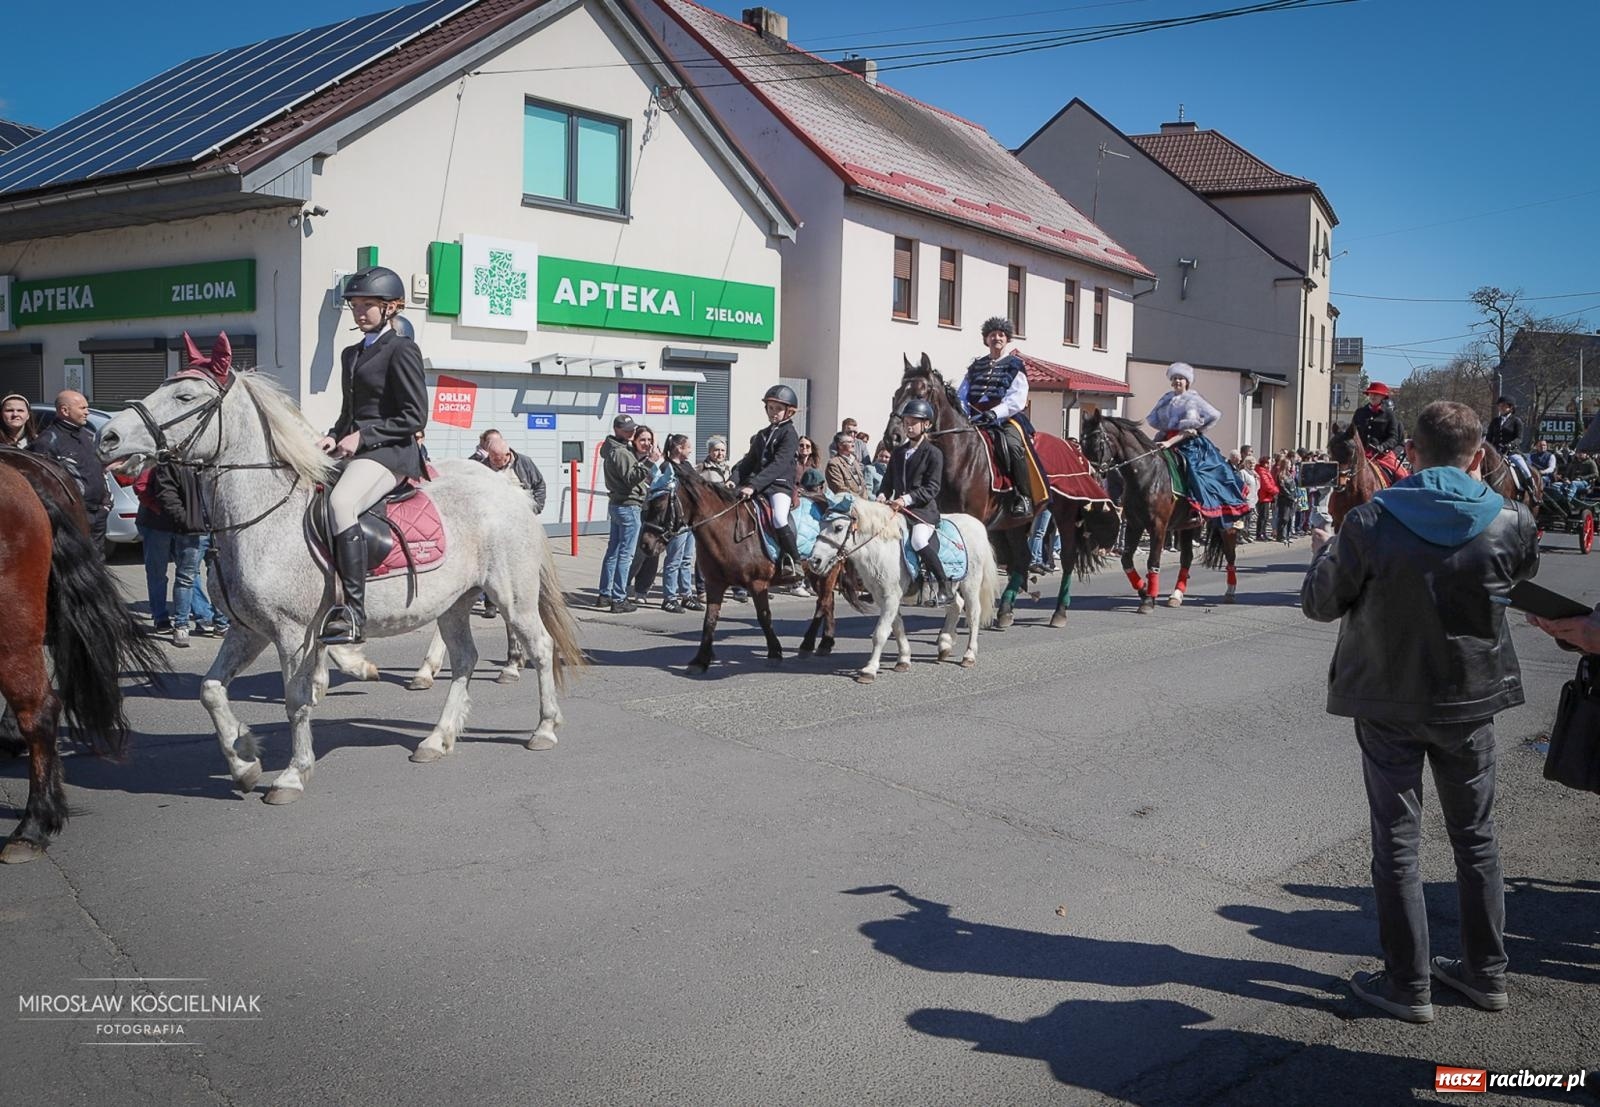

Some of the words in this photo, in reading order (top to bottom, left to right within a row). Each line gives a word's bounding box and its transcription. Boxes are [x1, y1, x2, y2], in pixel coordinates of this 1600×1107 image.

[20, 285, 94, 313] APTEKA
[171, 281, 236, 302] ZIELONA
[553, 277, 680, 316] APTEKA
[705, 307, 763, 326] ZIELONA
[438, 393, 471, 402] ORLEN
[438, 402, 471, 413] paczka
